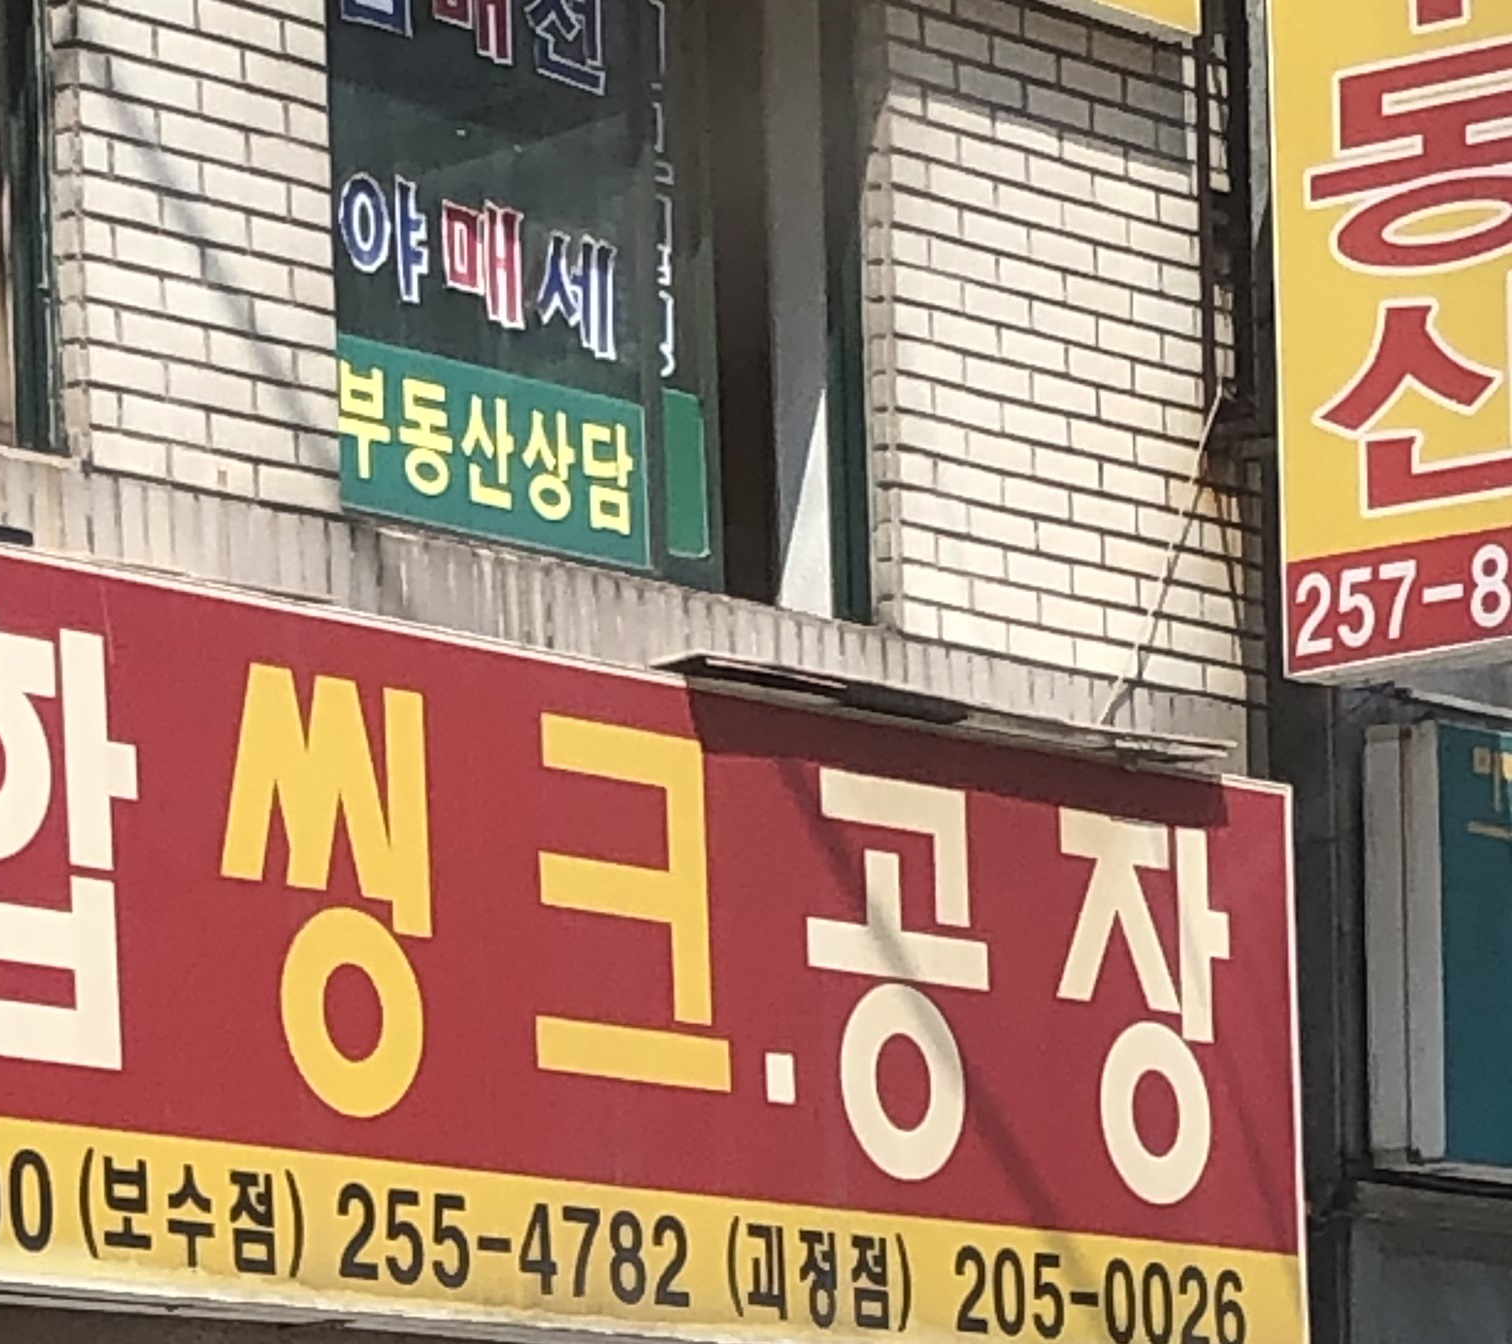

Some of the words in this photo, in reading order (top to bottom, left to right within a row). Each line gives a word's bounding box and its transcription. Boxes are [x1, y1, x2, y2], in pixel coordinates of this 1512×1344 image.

[339, 358, 635, 537] 부동산상담
[79, 1146, 305, 1278] (보수점)
[339, 1181, 691, 1308] 255-4782
[727, 1215, 913, 1333] (괴정점)
